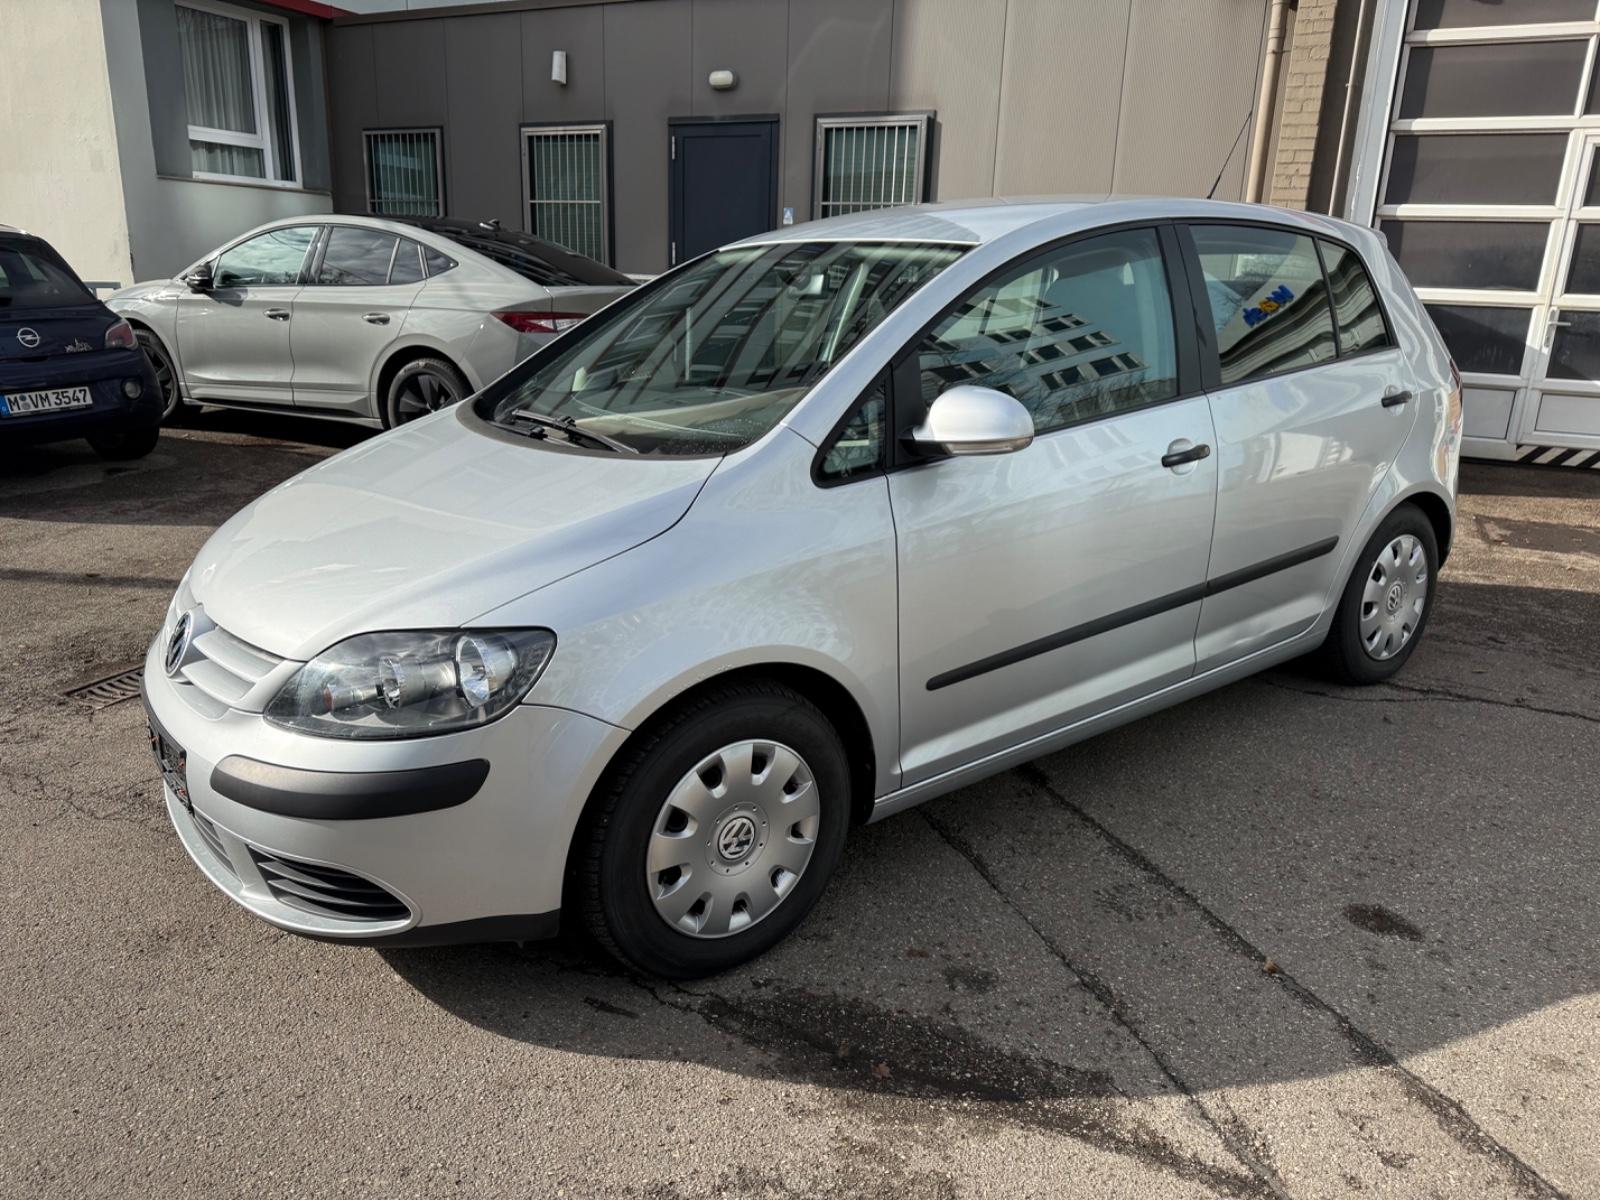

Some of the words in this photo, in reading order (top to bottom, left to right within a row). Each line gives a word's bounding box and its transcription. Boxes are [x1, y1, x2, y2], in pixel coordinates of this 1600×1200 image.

[7, 397, 21, 412] M
[28, 393, 52, 409] VM
[52, 388, 87, 406] 3547
